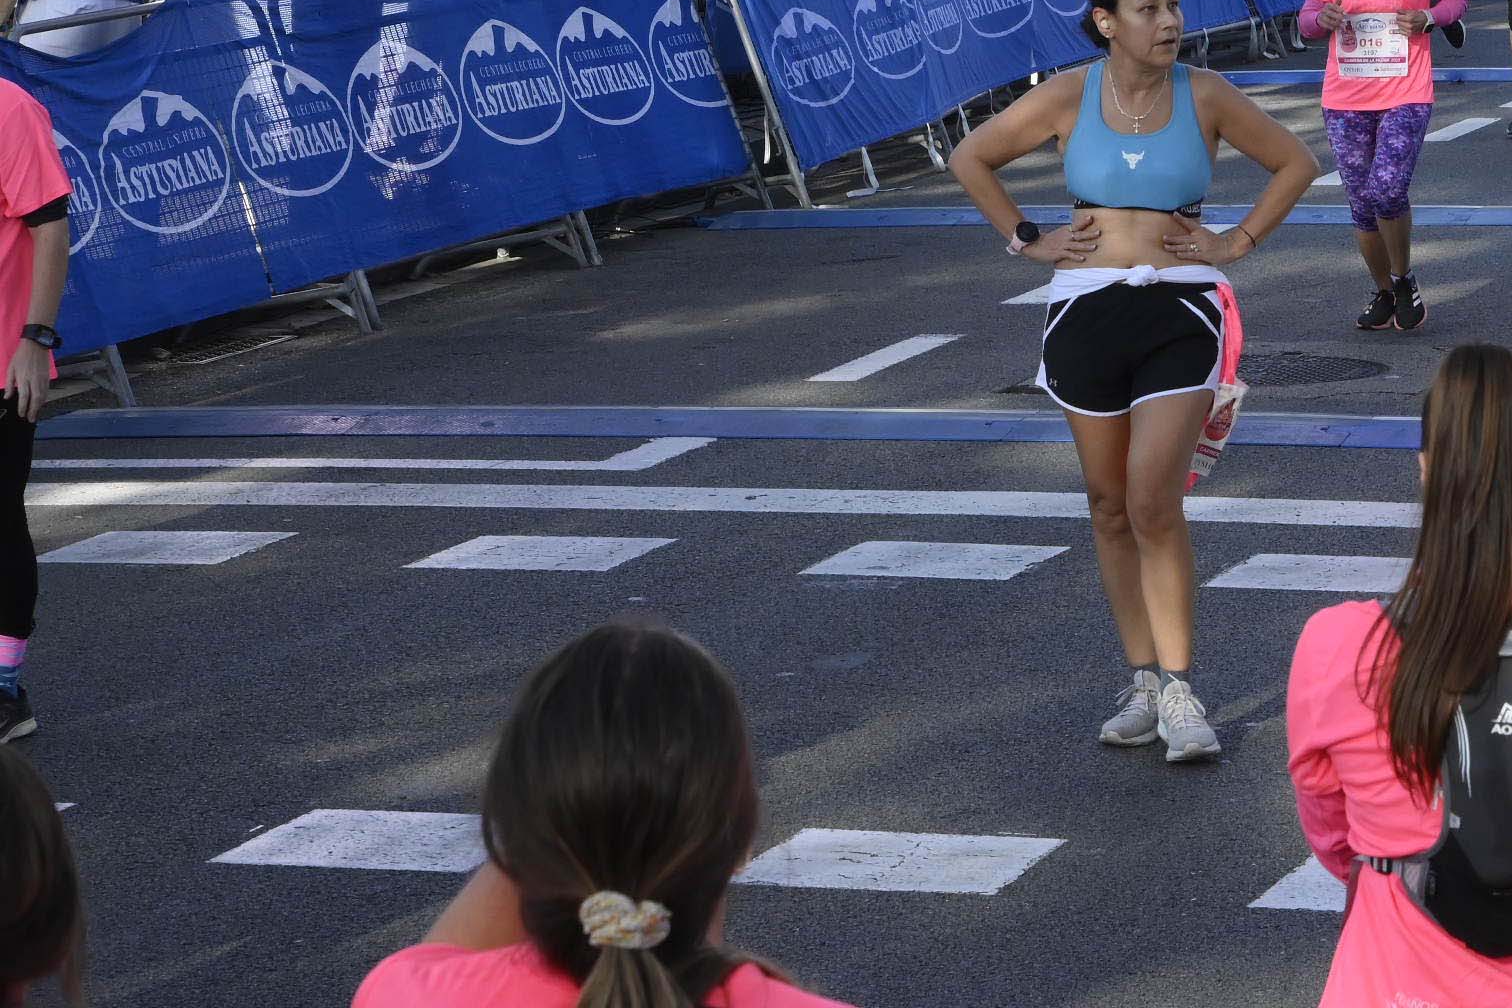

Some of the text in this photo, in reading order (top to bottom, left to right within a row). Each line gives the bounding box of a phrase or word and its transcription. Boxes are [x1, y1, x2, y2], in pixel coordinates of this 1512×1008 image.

[573, 43, 633, 62] CENTRAL LECHERA
[1359, 38, 1383, 48] 016
[479, 57, 547, 79] CENTRAL LECHERA
[565, 55, 651, 101] ASTURIANA
[469, 70, 562, 119] ASTURIANA
[122, 138, 167, 158] CENTRAL
[243, 117, 348, 169] ASTURIANA
[111, 145, 225, 206] ASTURIANA
